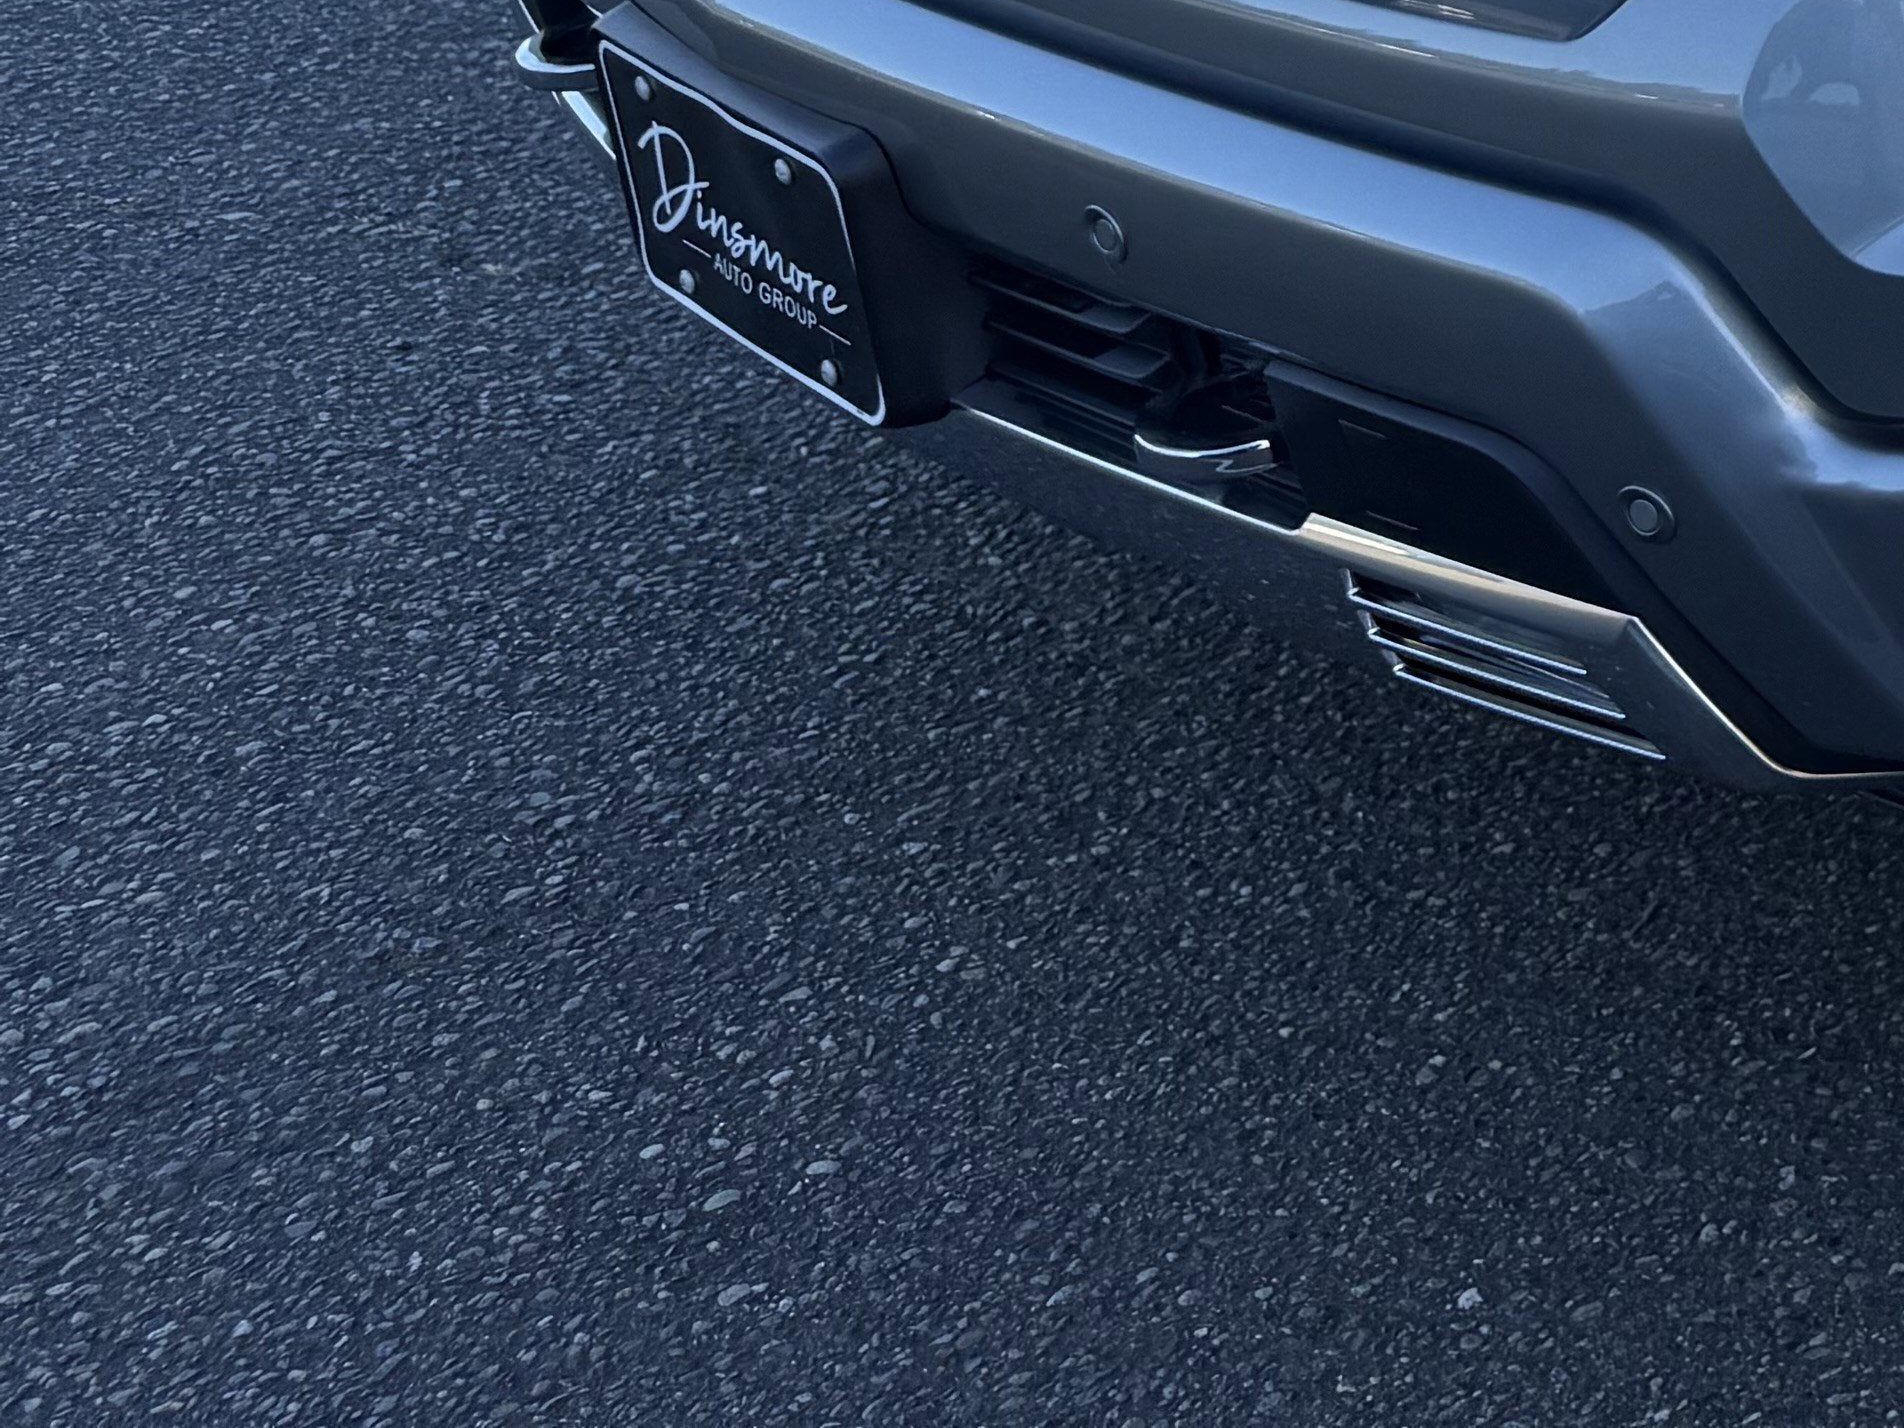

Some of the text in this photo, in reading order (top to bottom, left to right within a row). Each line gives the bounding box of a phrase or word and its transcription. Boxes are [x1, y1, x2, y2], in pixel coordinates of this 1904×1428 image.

[637, 120, 848, 315] Dinsmore
[713, 253, 818, 329] AUTO GROUP
